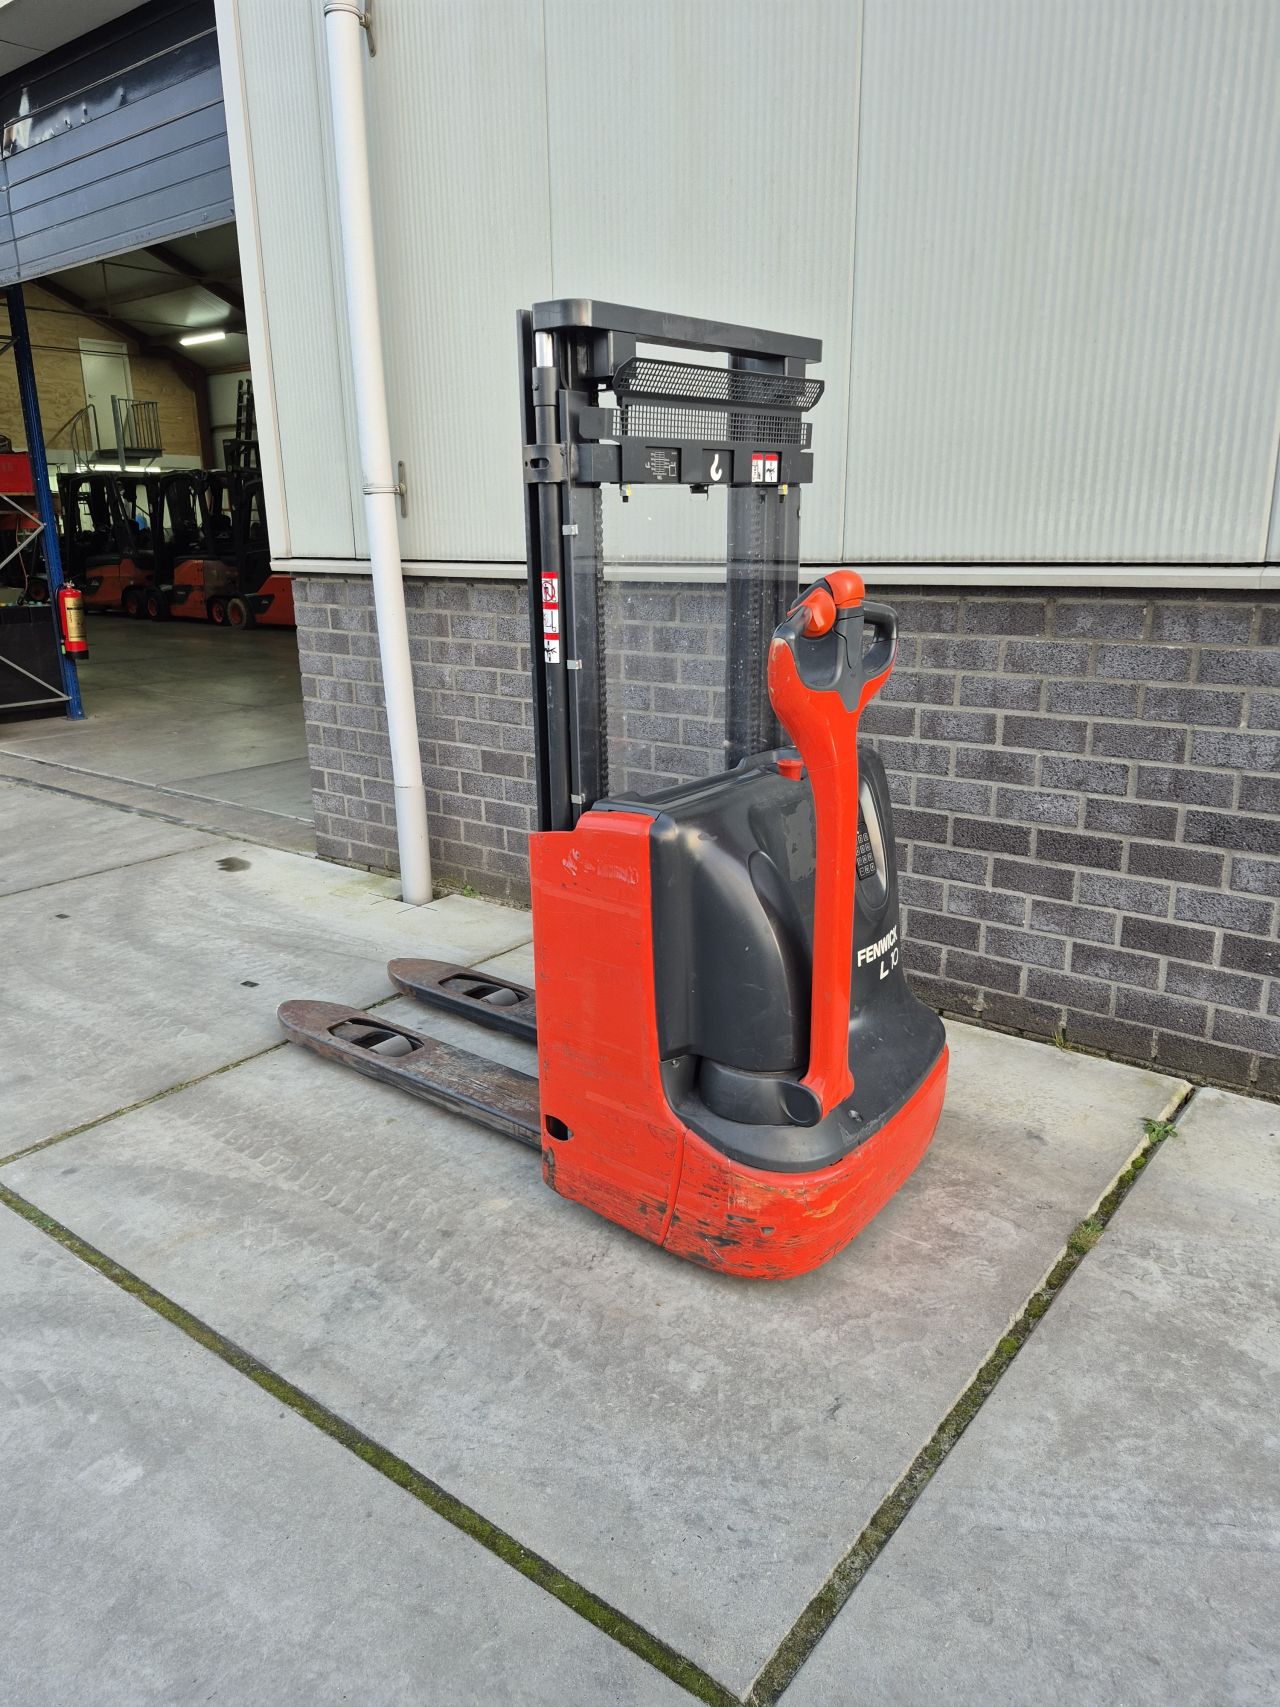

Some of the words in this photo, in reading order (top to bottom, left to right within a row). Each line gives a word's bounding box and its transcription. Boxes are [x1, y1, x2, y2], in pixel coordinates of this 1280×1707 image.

[857, 924, 898, 968] FENWICK
[880, 960, 889, 980] L
[890, 947, 898, 970] 10
